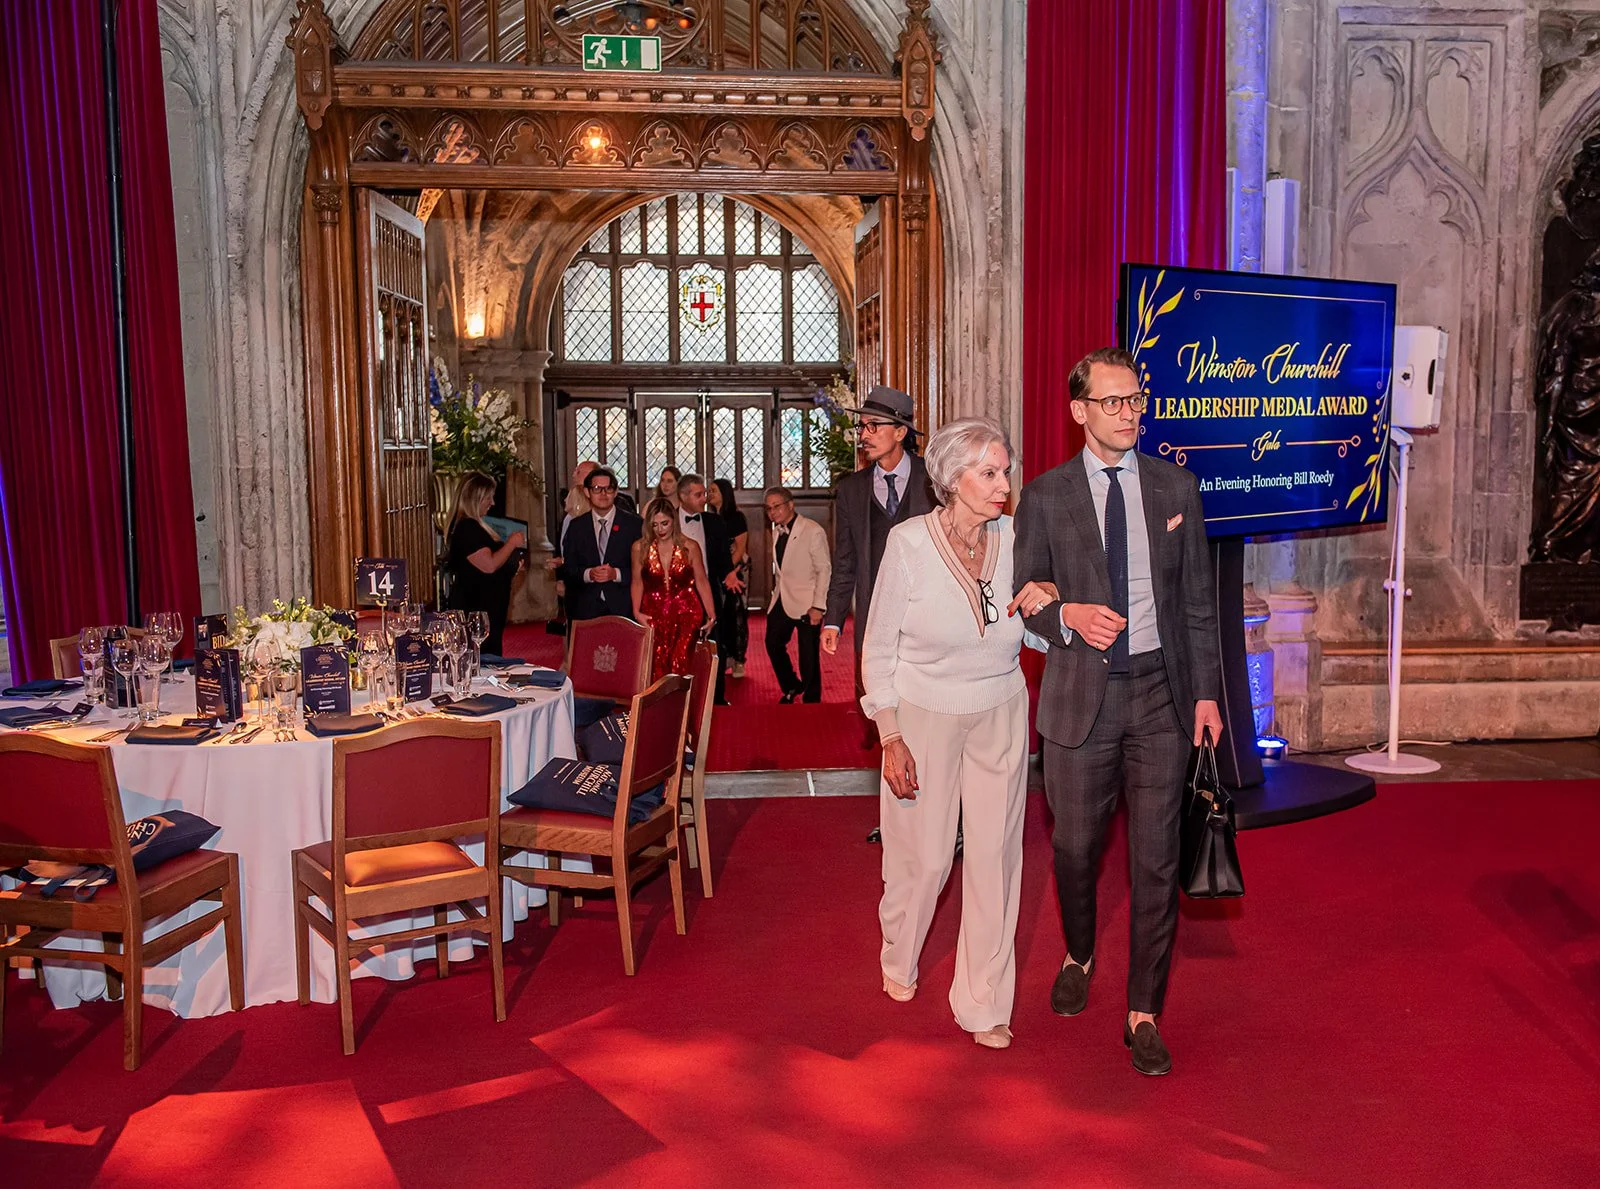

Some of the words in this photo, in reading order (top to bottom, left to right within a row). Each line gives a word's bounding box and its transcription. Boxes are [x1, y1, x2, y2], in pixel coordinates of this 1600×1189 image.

[1177, 336, 1257, 383] Winston
[1262, 342, 1351, 384] Churchill
[1154, 397, 1259, 419] LEADERSHIP
[1262, 397, 1315, 418] MEDAL
[1316, 396, 1368, 416] AWARD
[1252, 430, 1282, 461] Gala
[1199, 478, 1213, 492] An
[1215, 476, 1251, 493] Evening
[1252, 473, 1292, 490] Honoring
[1293, 472, 1308, 486] Bill
[1309, 471, 1334, 487] Roedy
[368, 571, 394, 595] 14
